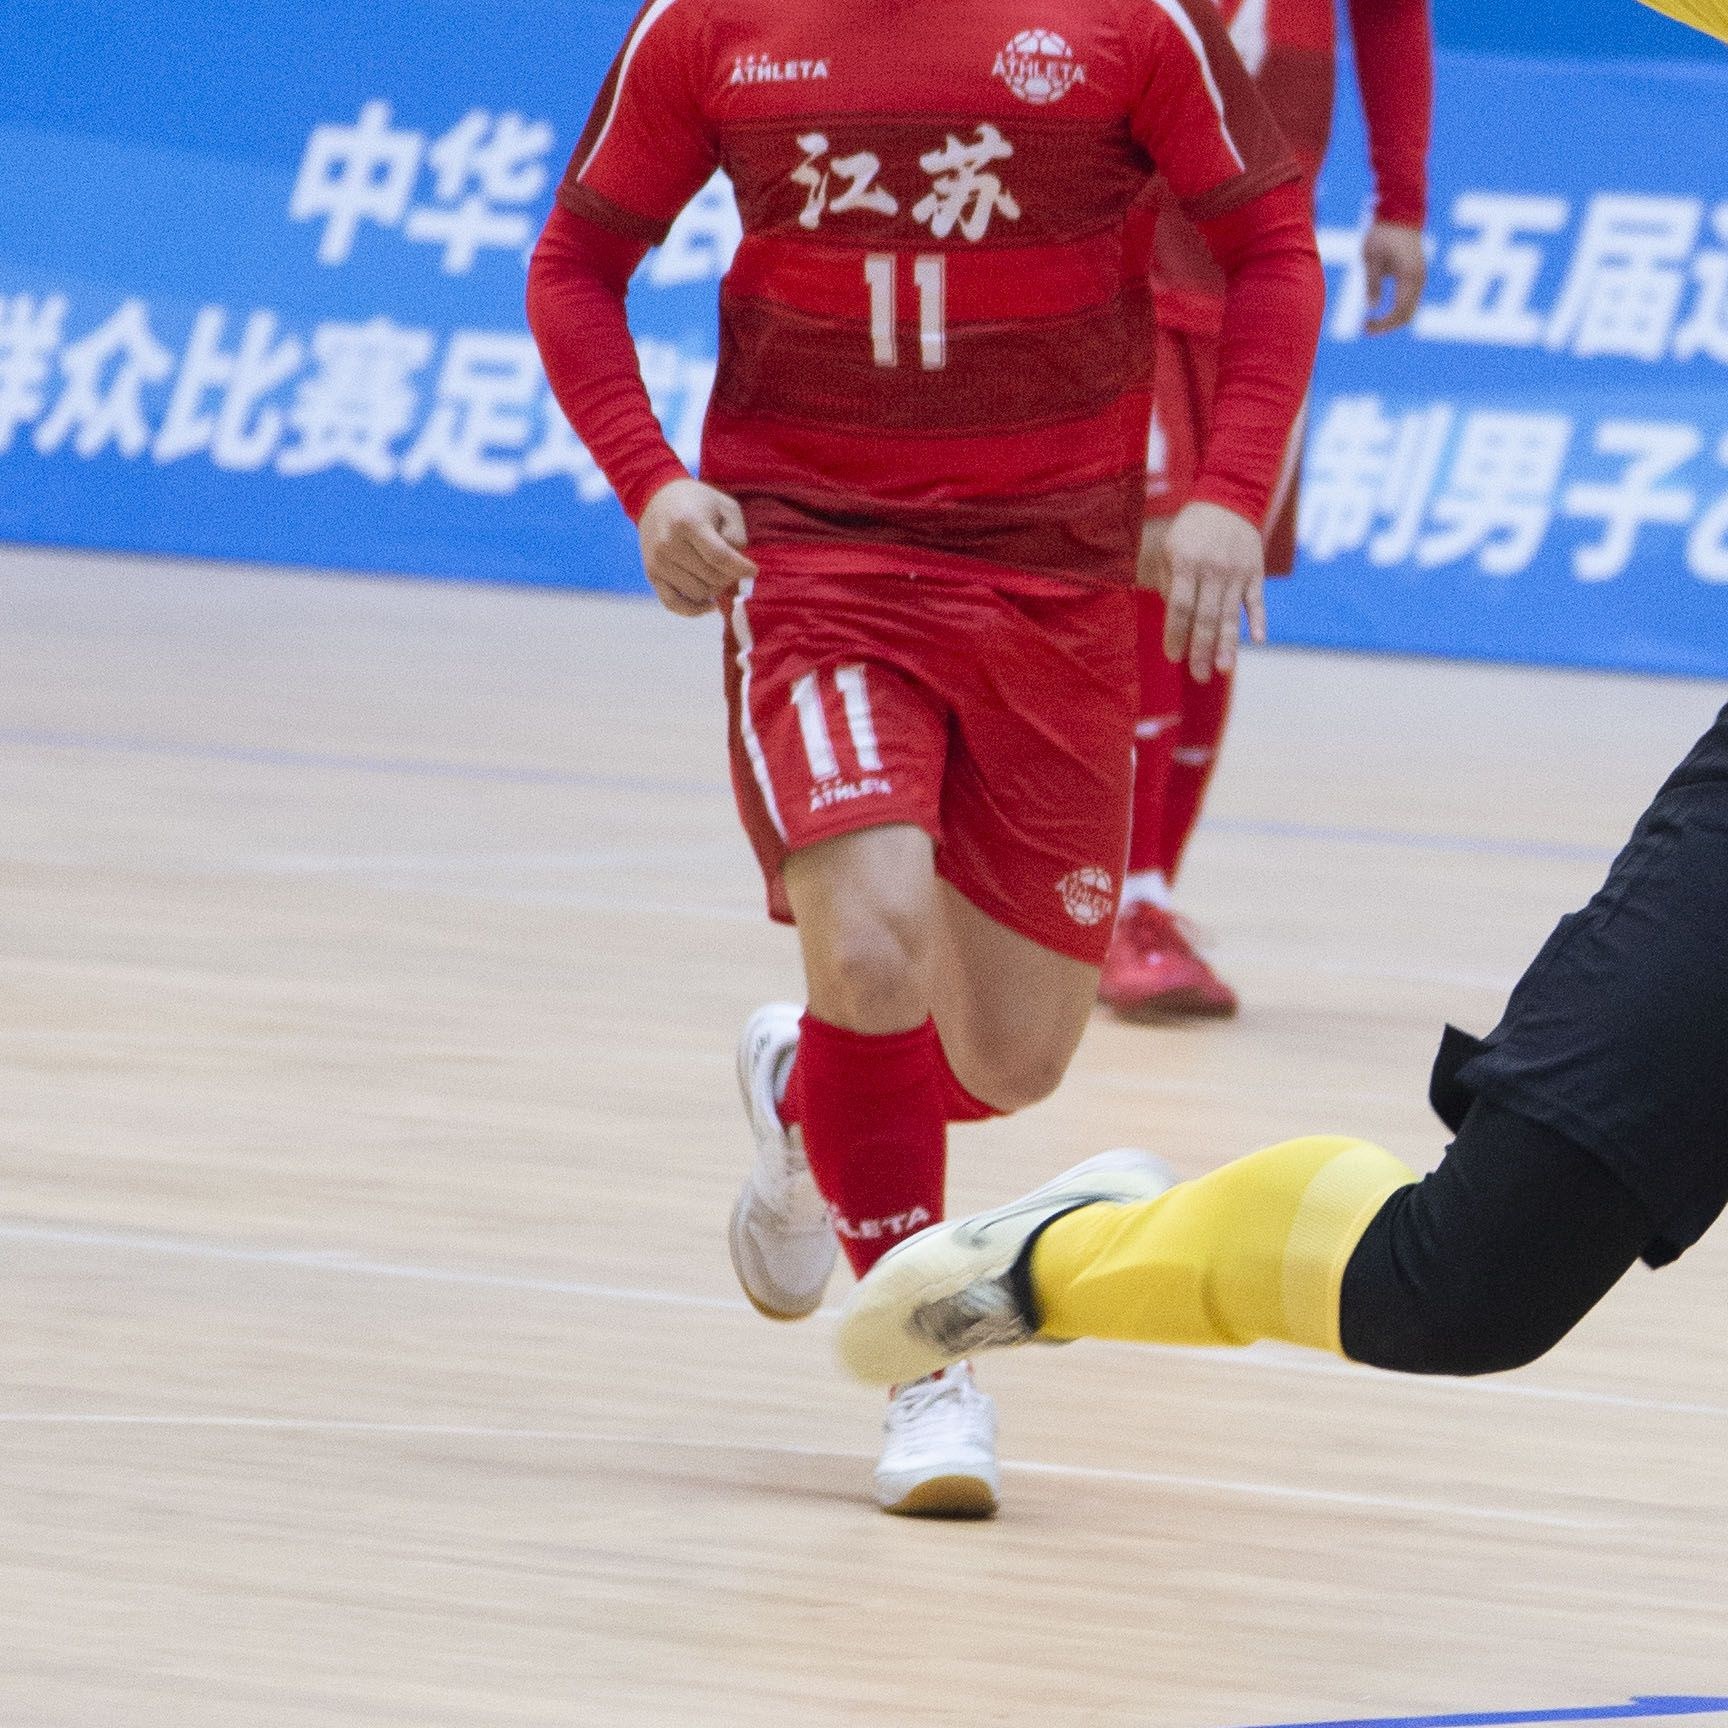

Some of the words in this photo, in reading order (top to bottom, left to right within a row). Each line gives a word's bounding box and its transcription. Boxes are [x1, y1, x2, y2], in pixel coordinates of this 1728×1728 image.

[730, 54, 830, 85] ATHLETA
[791, 123, 1021, 241] 江苏
[864, 253, 947, 370] 11
[791, 663, 884, 783] 11
